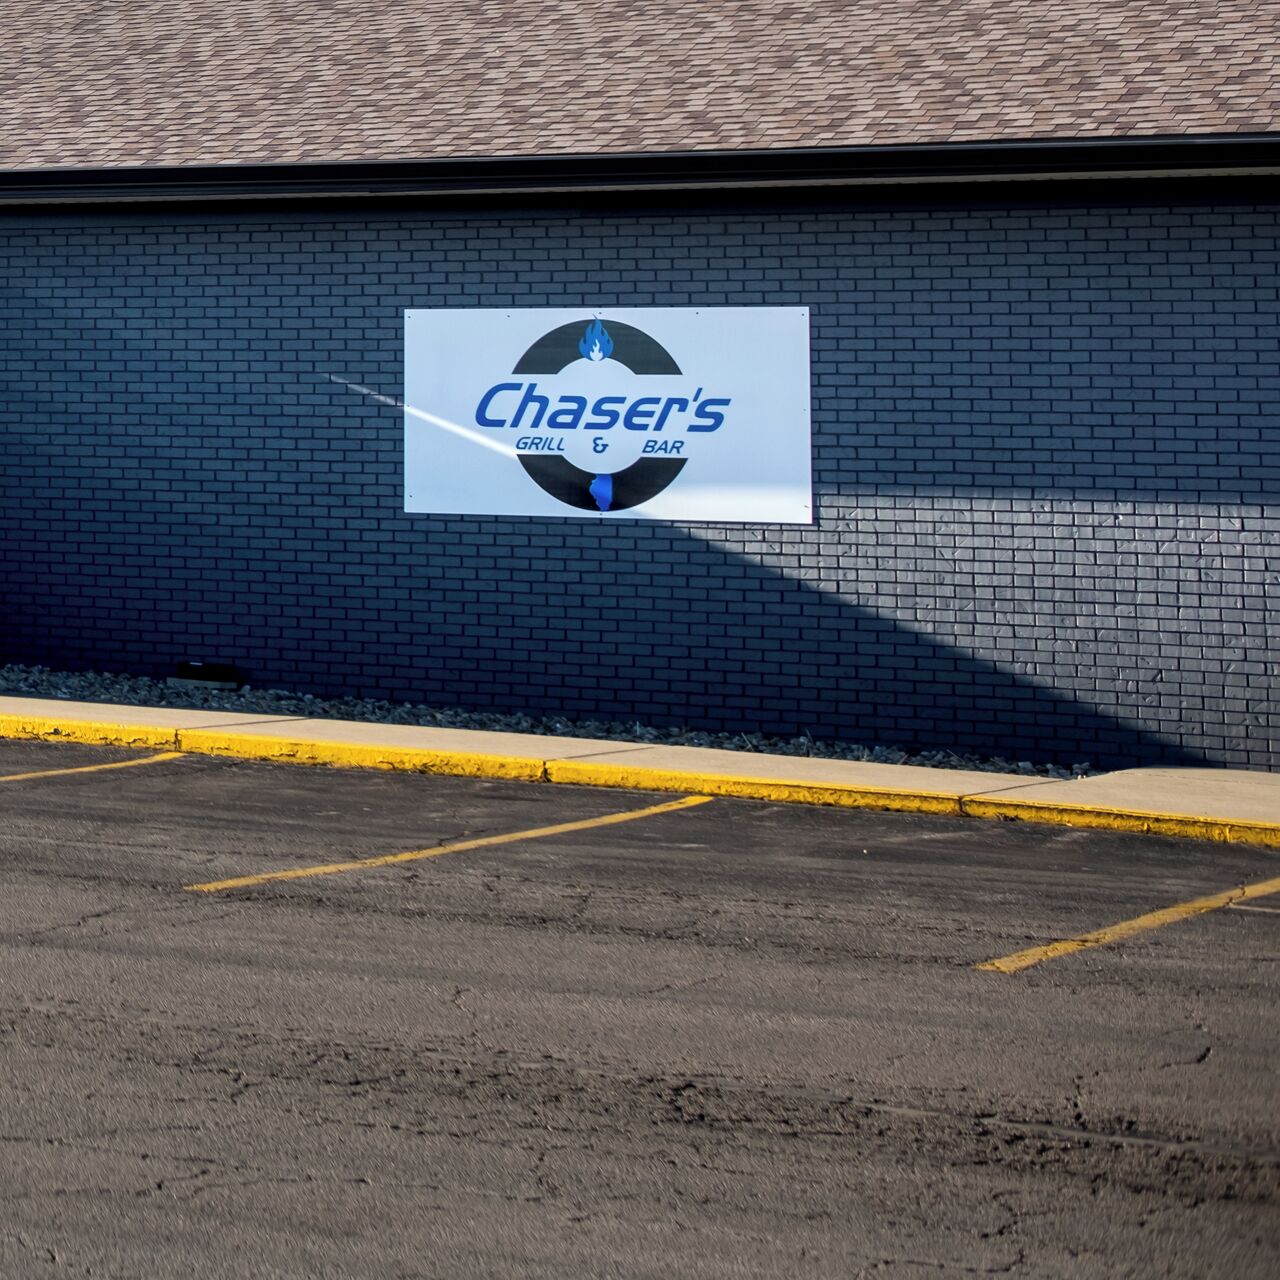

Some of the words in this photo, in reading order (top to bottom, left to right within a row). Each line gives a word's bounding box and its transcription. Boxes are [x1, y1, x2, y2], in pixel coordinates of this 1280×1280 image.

[475, 382, 731, 433] Chaser's
[516, 436, 565, 452] GRILL
[593, 436, 609, 454] &
[642, 440, 684, 455] BAR
